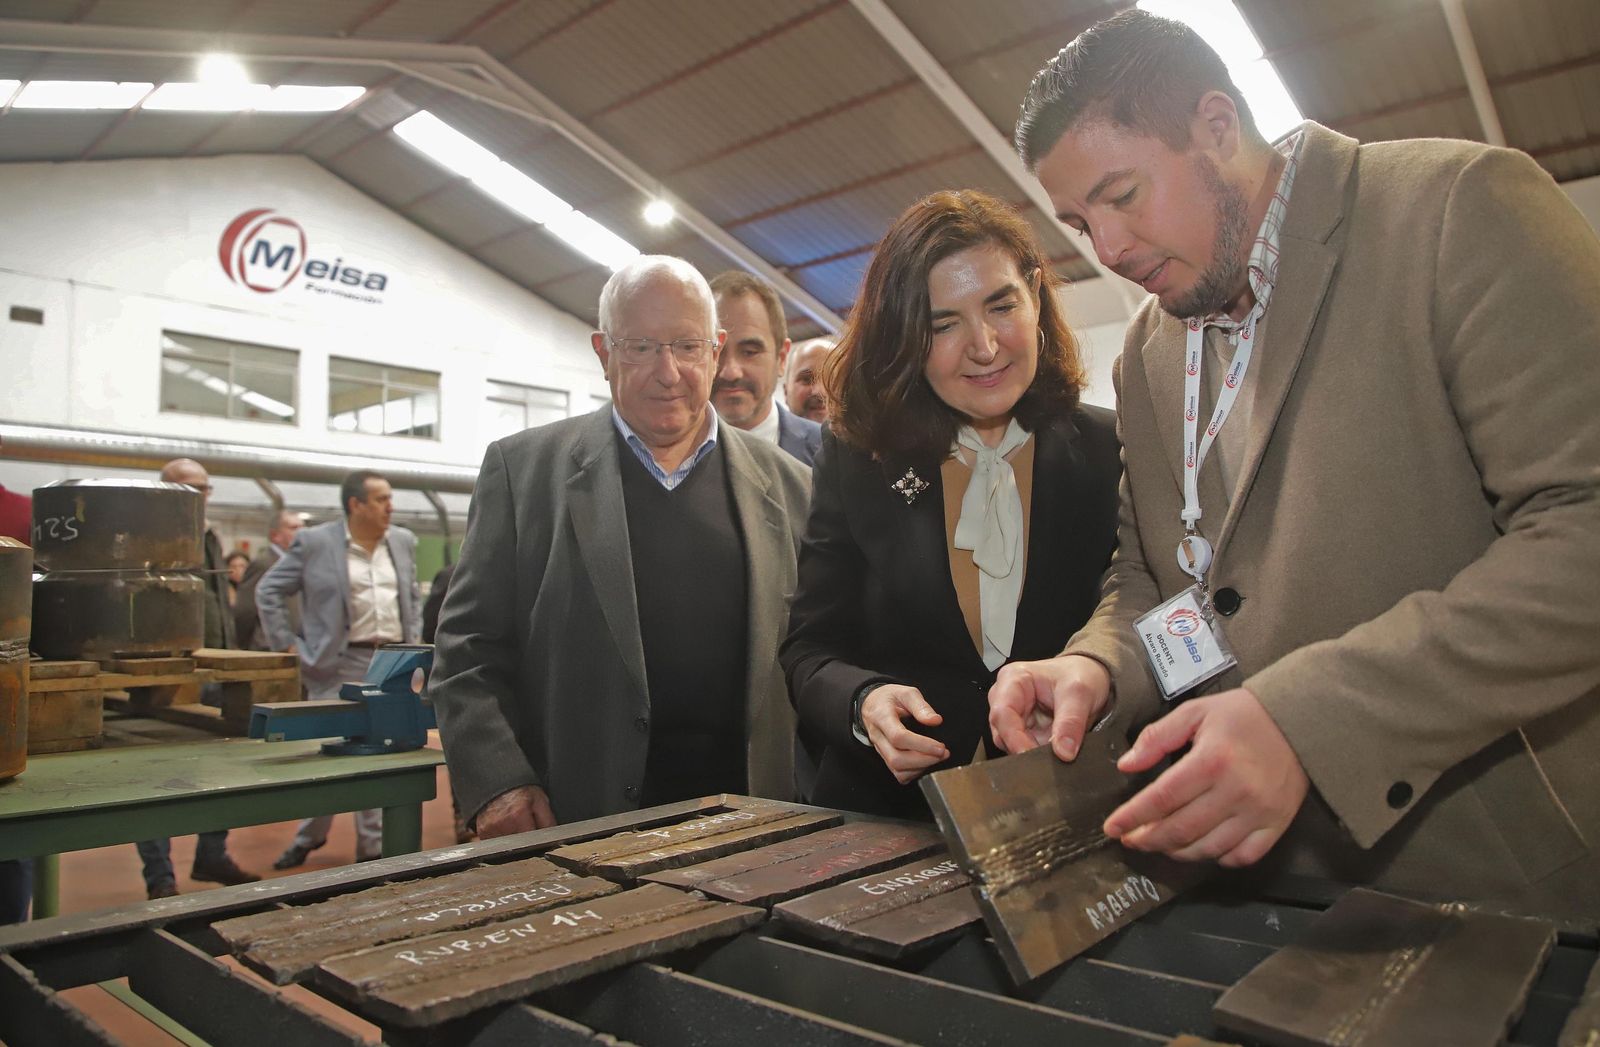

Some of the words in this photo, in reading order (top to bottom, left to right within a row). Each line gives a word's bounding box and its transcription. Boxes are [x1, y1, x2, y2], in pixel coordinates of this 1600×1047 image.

[250, 239, 388, 291] Meisa
[1155, 653, 1169, 678] Rosado
[1156, 633, 1175, 666] DOCENTE
